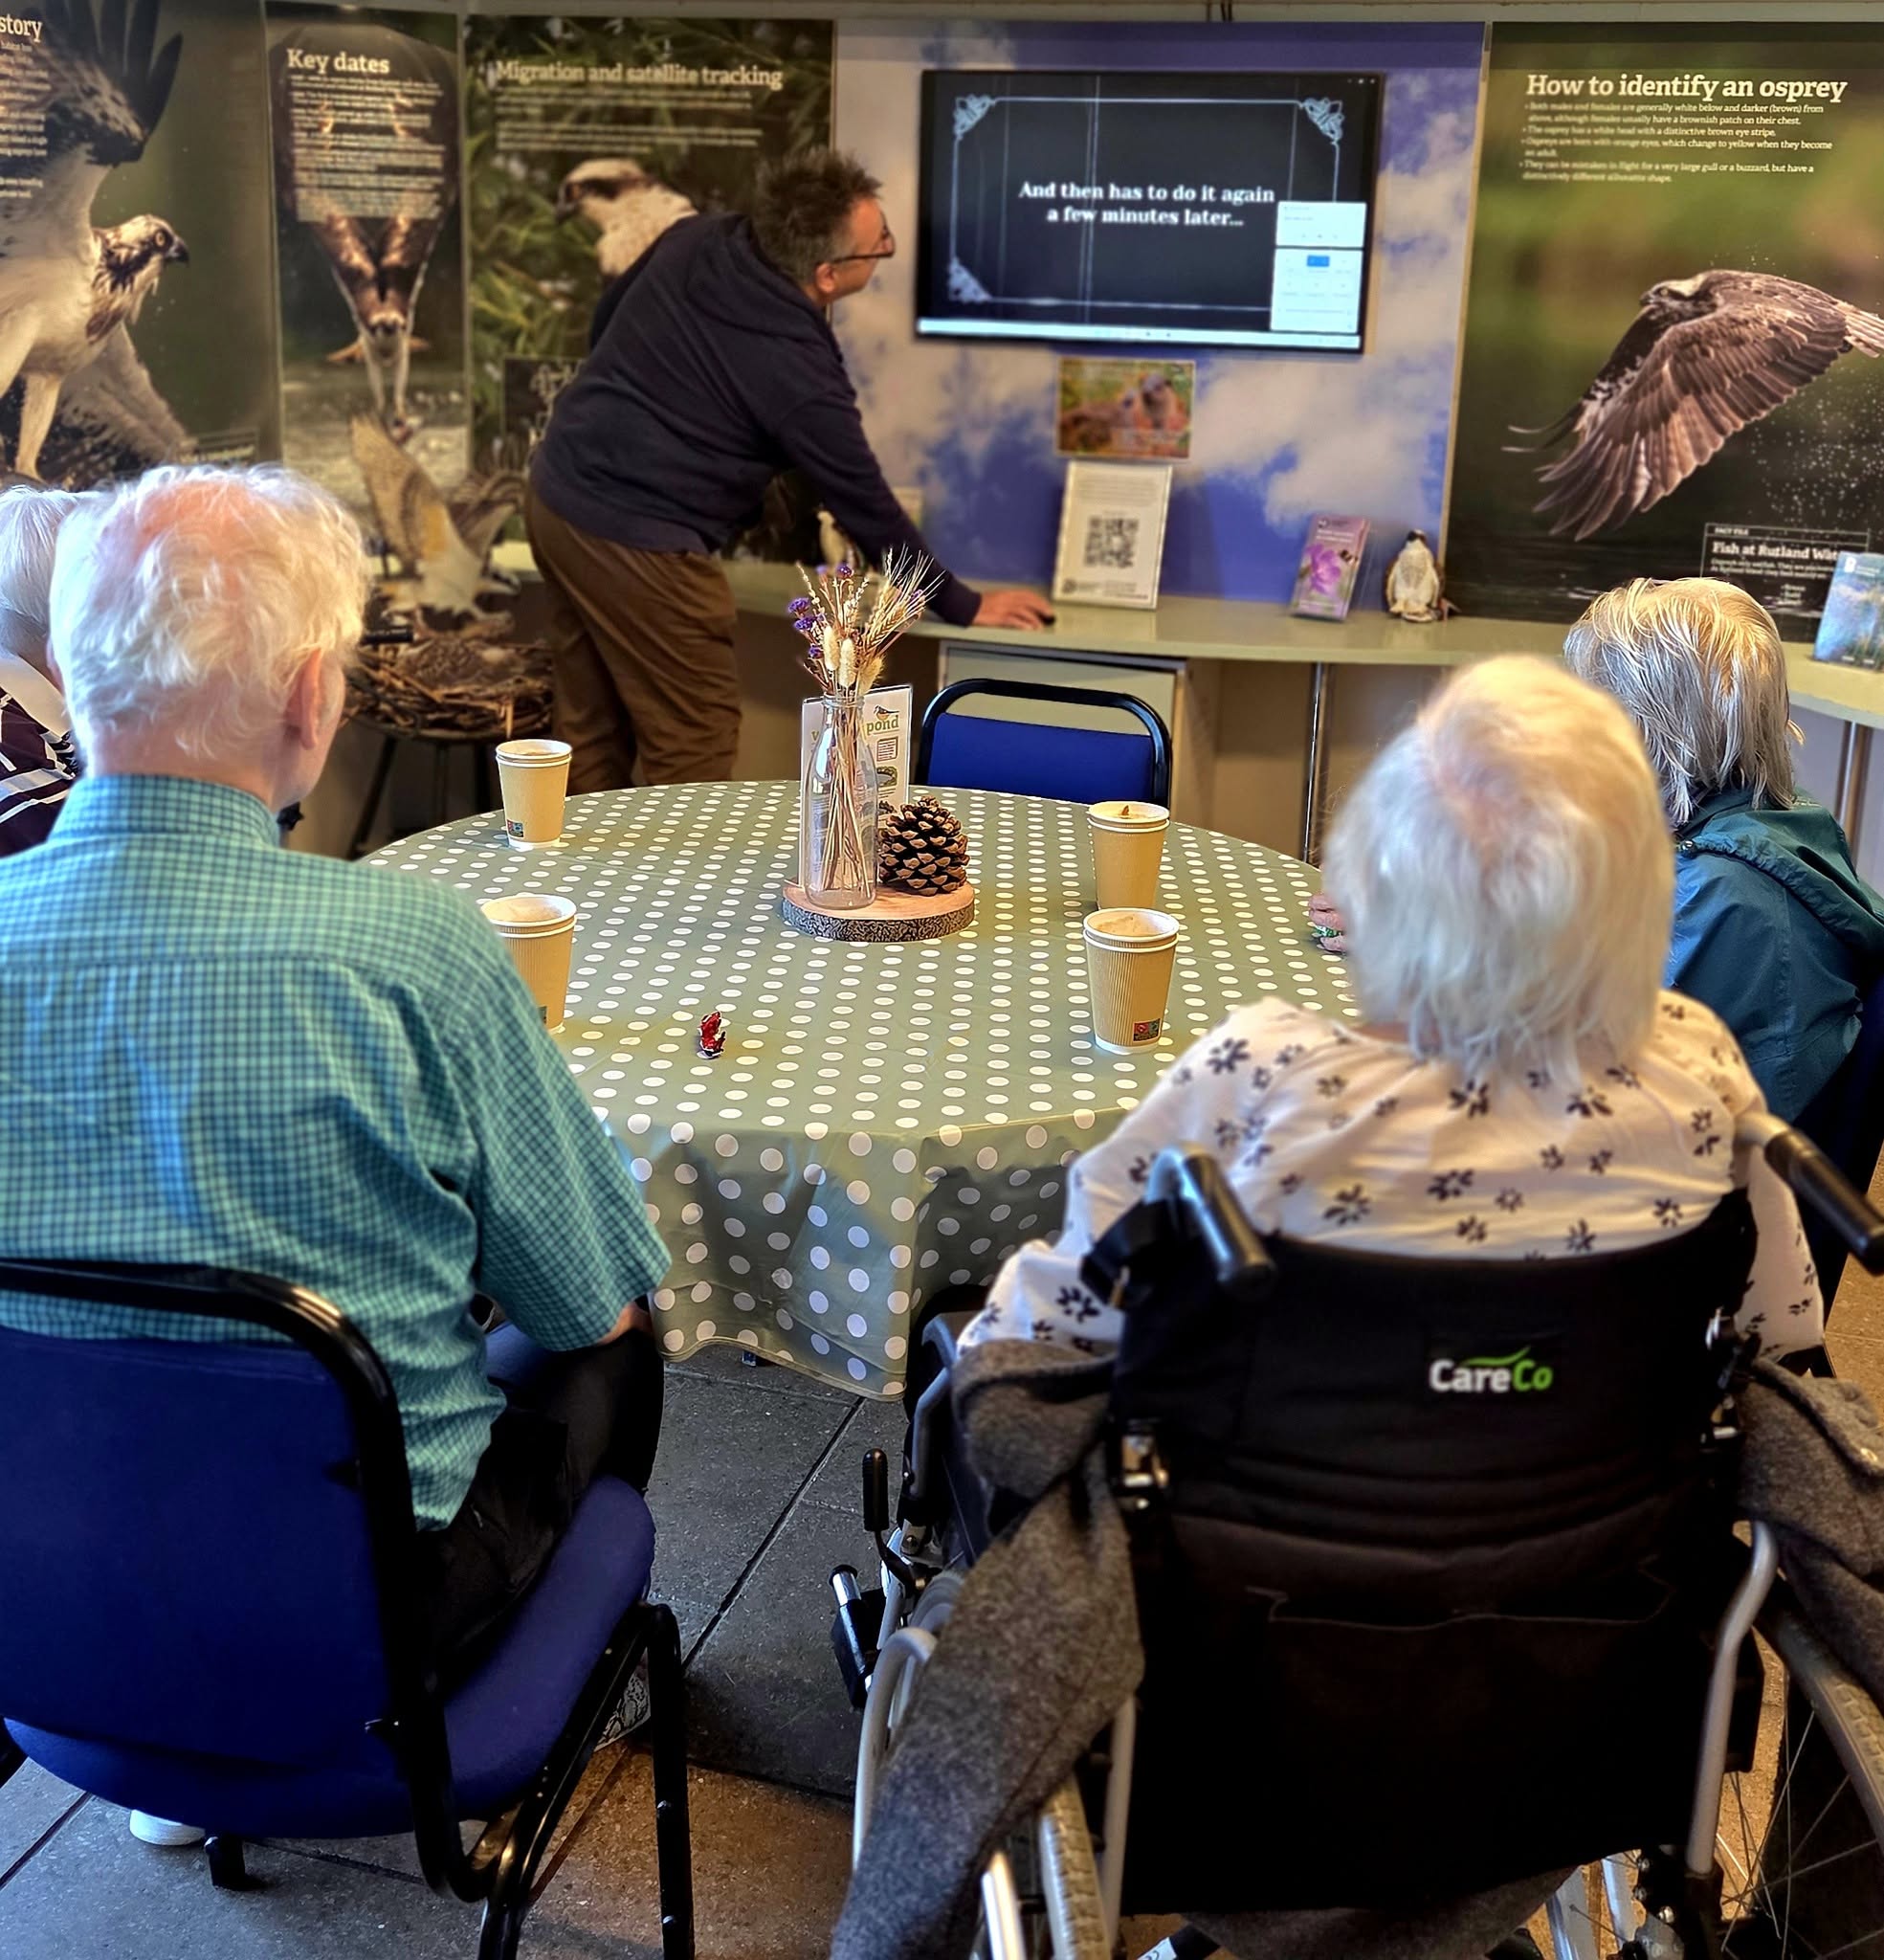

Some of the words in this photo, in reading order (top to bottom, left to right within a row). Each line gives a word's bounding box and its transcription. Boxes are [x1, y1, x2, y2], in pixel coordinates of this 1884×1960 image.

[287, 49, 329, 74] Key
[334, 51, 390, 74] dates
[496, 60, 586, 85] Migration
[588, 62, 622, 81] and
[627, 63, 699, 84] satellite
[702, 65, 784, 91] tracking
[1526, 74, 1585, 96] How
[1588, 76, 1614, 96] to
[1618, 73, 1719, 102] identify
[1722, 79, 1754, 97] an
[1759, 80, 1849, 103] osprey
[1636, 102, 1673, 113] generally
[1674, 103, 1697, 112] white
[1698, 103, 1723, 112] below
[1723, 103, 1740, 112] and
[1740, 103, 1768, 113] darker
[1769, 104, 1803, 113] (brown)
[1803, 104, 1824, 113] from
[1652, 114, 1673, 123] have
[1679, 115, 1718, 124] brownish
[1719, 116, 1742, 126] patch
[1756, 116, 1777, 124] their
[1777, 116, 1801, 125] chest.
[1663, 126, 1707, 136] distinctive
[1707, 127, 1735, 136] brown
[1735, 129, 1750, 138] eye
[1661, 138, 1687, 147] which
[1688, 139, 1718, 149] change
[1728, 139, 1757, 149] yellow
[1757, 140, 1780, 148] when
[1781, 140, 1801, 150] they
[1801, 140, 1834, 150] become
[1660, 163, 1679, 172] very
[1680, 162, 1701, 172] large
[1701, 162, 1718, 173] gull
[1736, 163, 1770, 172] buzzard,
[1771, 164, 1785, 172] but
[1786, 164, 1807, 173] have
[1018, 180, 1056, 199] And
[1060, 180, 1104, 200] then
[1109, 182, 1143, 201] has
[1147, 184, 1168, 201] to
[1172, 184, 1196, 202] do
[1201, 184, 1216, 202] it
[1221, 186, 1274, 207] again
[1047, 209, 1058, 222] a
[1063, 205, 1097, 223] few
[1101, 207, 1180, 225] minutes
[1184, 209, 1245, 226] later...
[1713, 541, 1740, 554] Fish
[1742, 545, 1755, 556] at
[1758, 544, 1810, 559] Rutland
[1812, 547, 1837, 561] Wat
[866, 715, 899, 735] pond
[1430, 1359, 1553, 1392] CareCo
